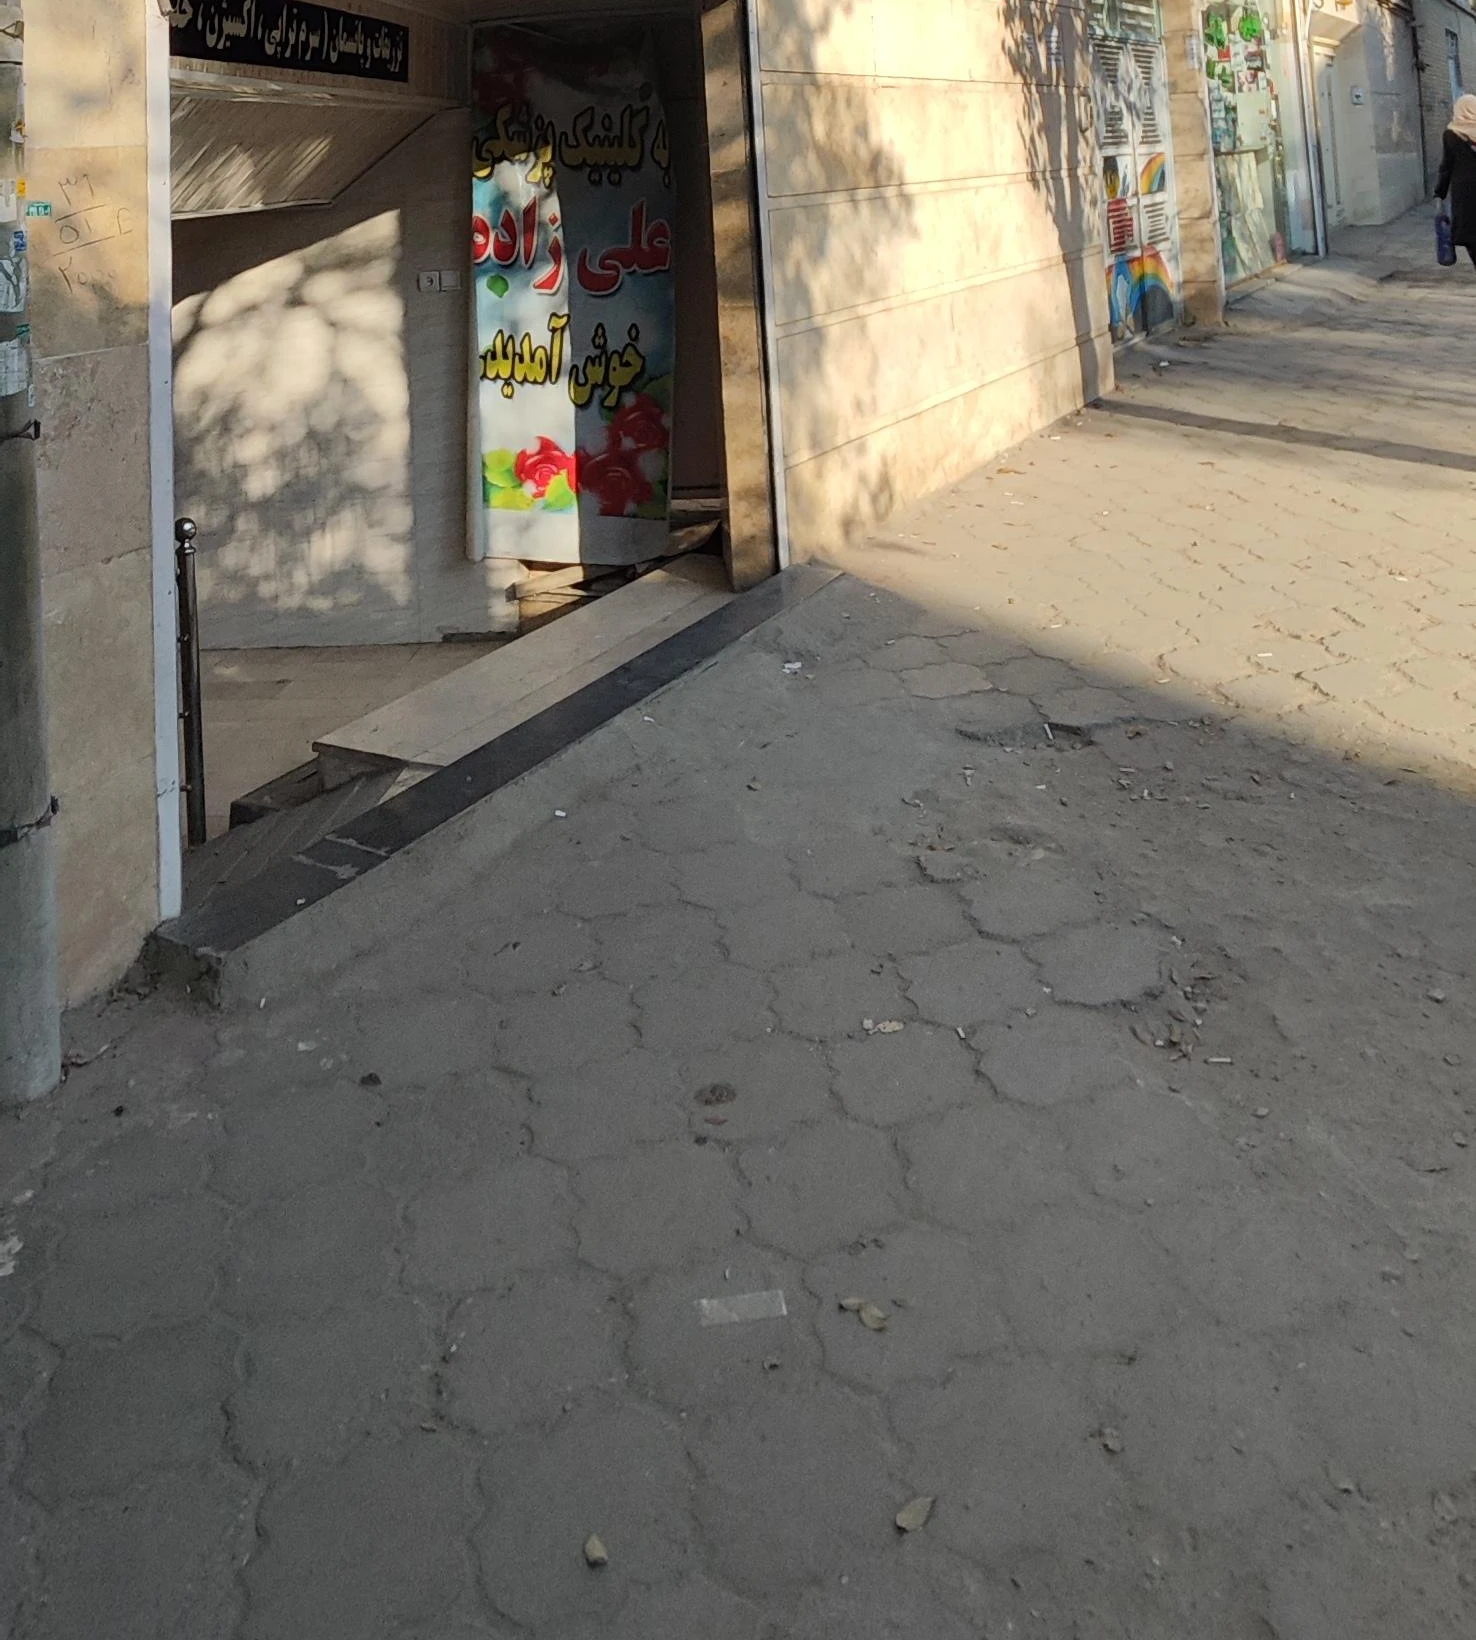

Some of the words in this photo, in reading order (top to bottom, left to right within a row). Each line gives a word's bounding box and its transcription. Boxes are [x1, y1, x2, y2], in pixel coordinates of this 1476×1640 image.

[330, 15, 364, 69] پانسمان
[365, 37, 371, 69] و
[372, 24, 404, 73] تزریقات
[471, 98, 556, 188] پزشکی
[558, 103, 649, 185] کلینیک
[651, 119, 672, 188] به
[577, 199, 672, 296] علی
[568, 322, 646, 408] خوش
